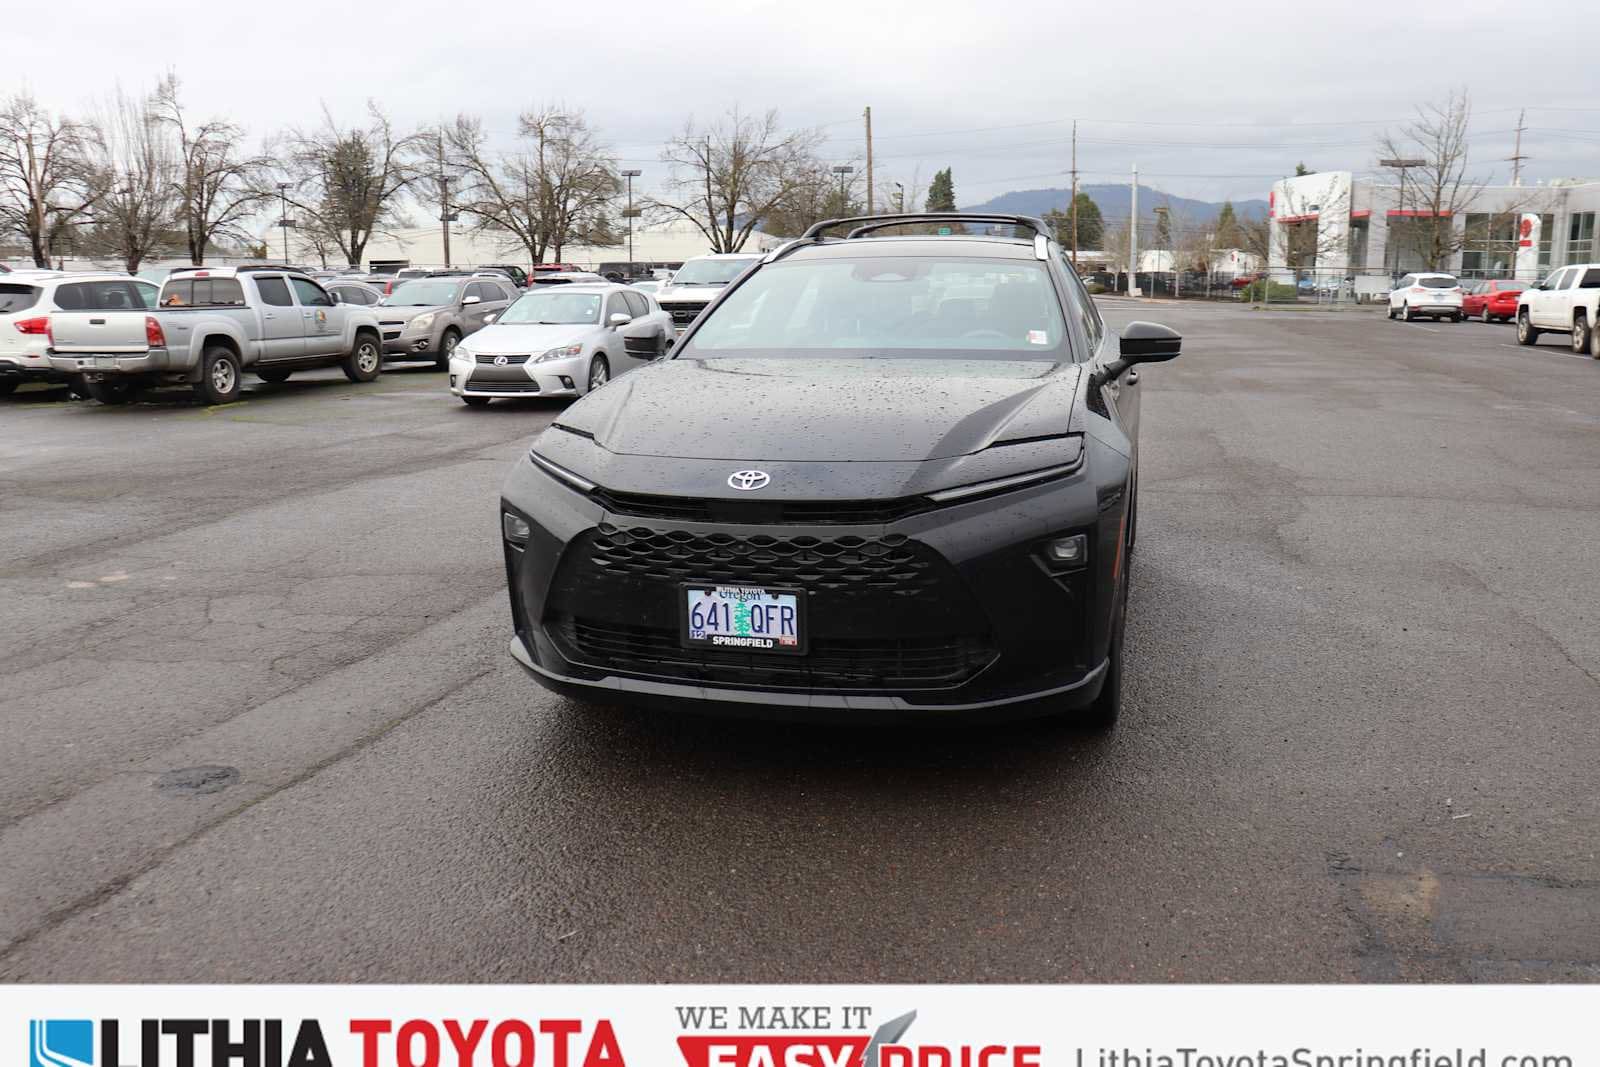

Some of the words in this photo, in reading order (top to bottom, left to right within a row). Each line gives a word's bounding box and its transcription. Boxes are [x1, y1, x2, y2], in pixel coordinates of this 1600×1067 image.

[719, 590, 761, 602] Oregon
[691, 601, 730, 632] 641
[750, 604, 794, 635] QFR
[712, 635, 774, 649] SPRINGFIELD
